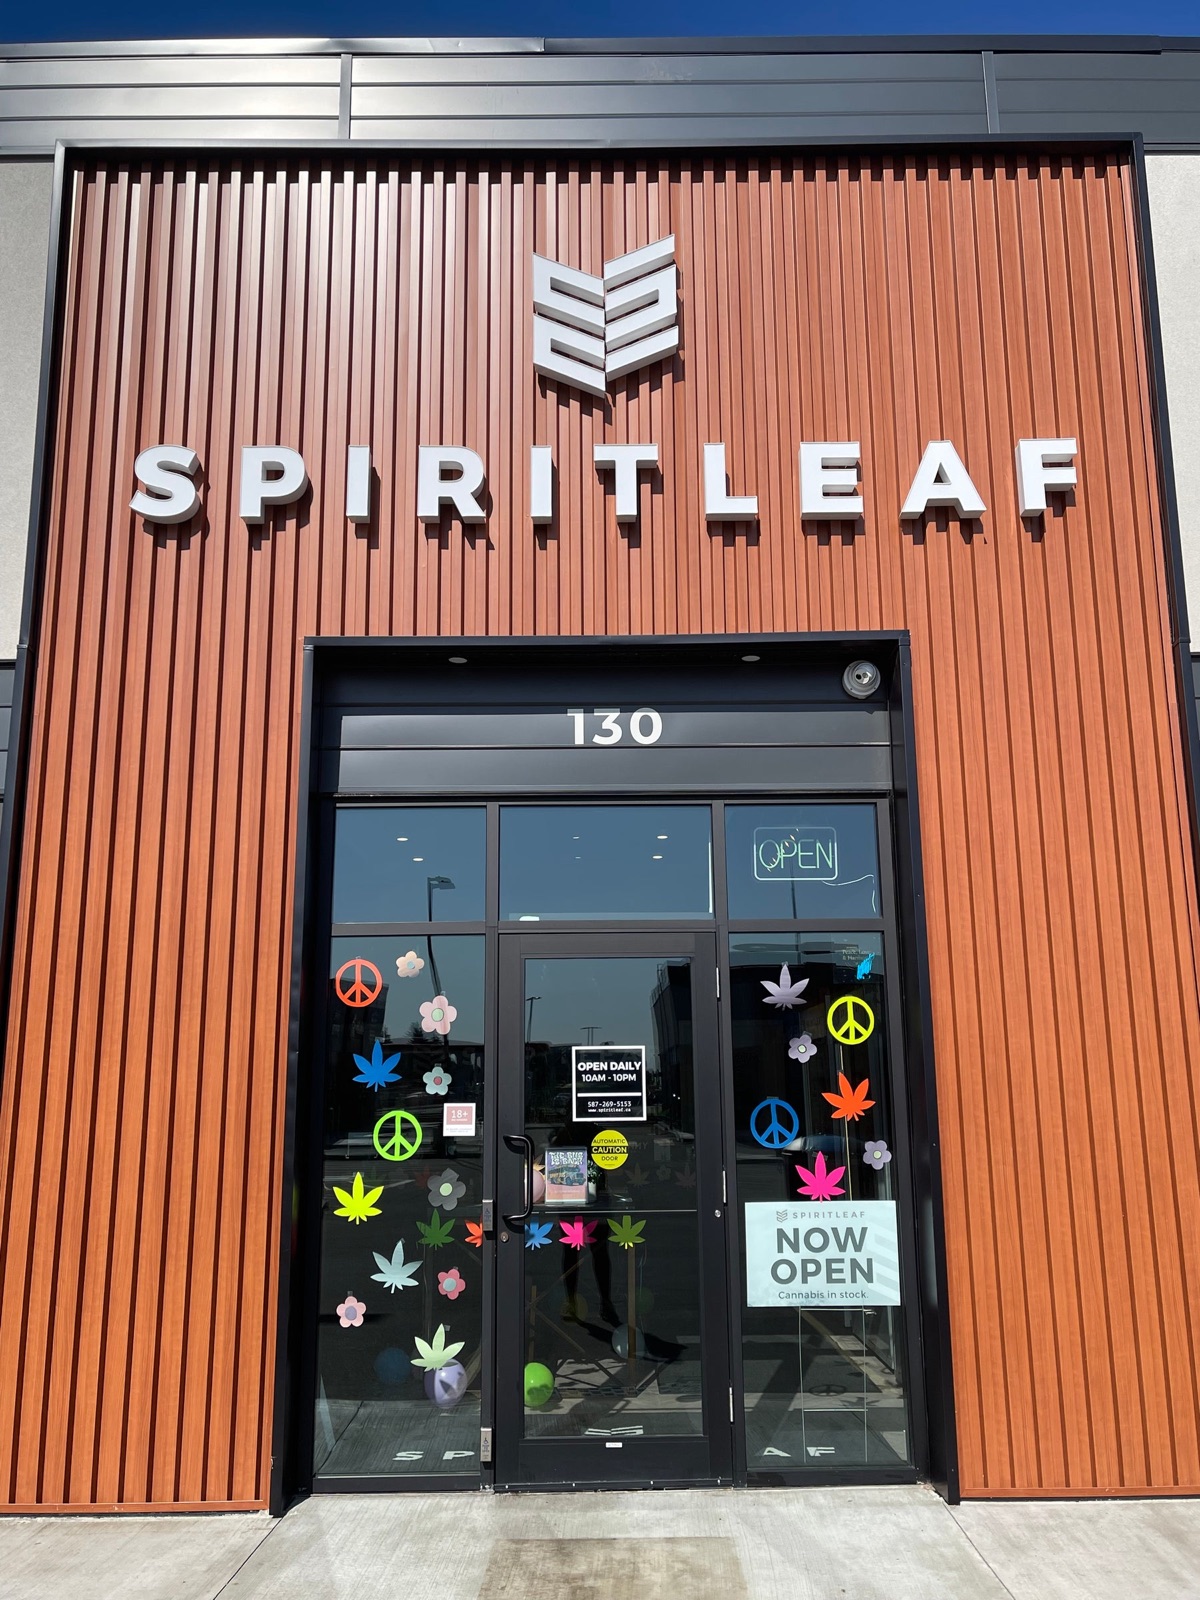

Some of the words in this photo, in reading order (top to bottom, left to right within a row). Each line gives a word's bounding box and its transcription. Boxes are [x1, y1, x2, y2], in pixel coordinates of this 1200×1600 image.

[129, 437, 1078, 525] SPIRITLEAF
[566, 707, 663, 745] 130
[759, 839, 833, 870] OPEN
[577, 1062, 608, 1072] OPEN
[610, 1061, 642, 1071] DAILY
[582, 1074, 606, 1082] 10AM
[613, 1073, 637, 1082] 10PM
[451, 1109, 468, 1118] 18+
[792, 1211, 866, 1219] SPIRITLEAF
[776, 1227, 868, 1253] NOW
[771, 1258, 874, 1285] OPEN
[778, 1290, 824, 1299] Cannabis
[827, 1290, 837, 1299] in
[839, 1290, 869, 1299] stock.
